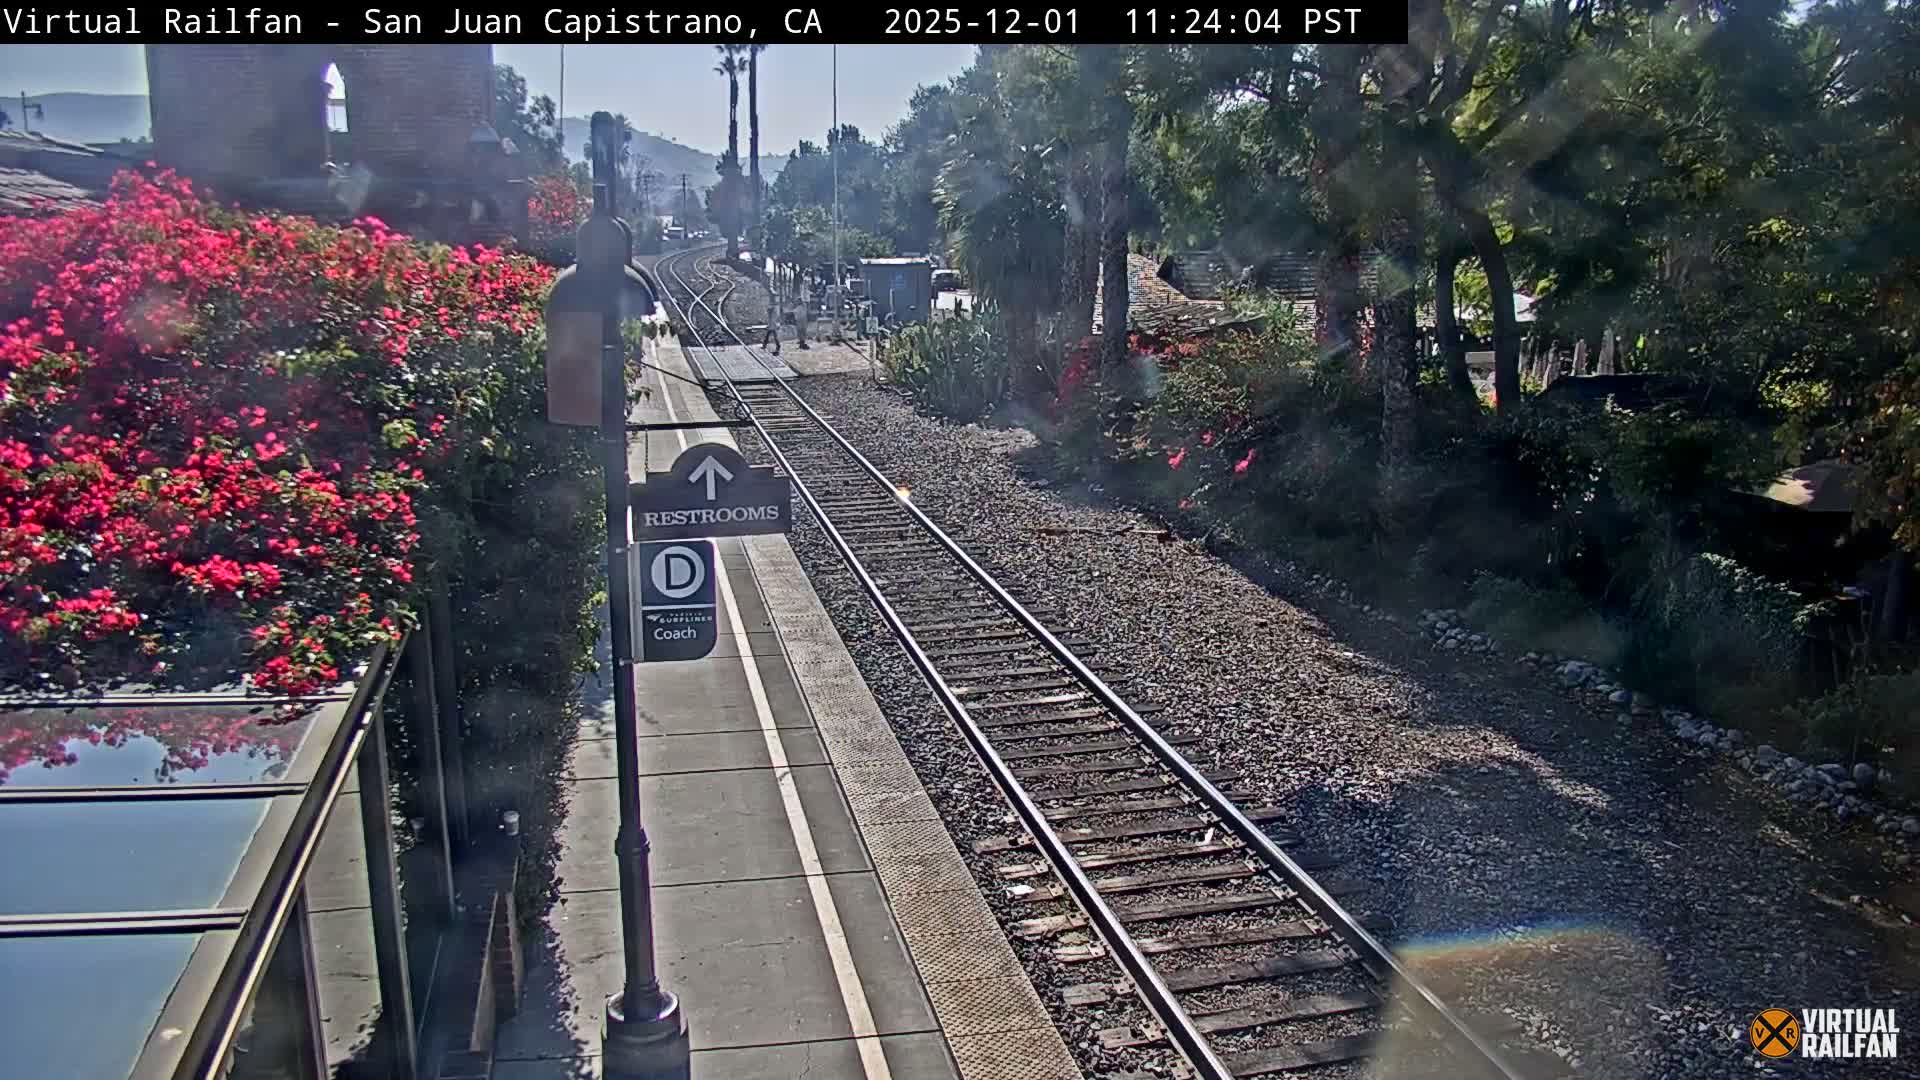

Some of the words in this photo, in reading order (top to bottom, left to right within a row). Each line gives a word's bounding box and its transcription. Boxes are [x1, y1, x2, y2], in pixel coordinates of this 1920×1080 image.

[643, 505, 780, 527] RESTROOMS
[664, 553, 697, 591] D
[654, 626, 697, 640] Coach
